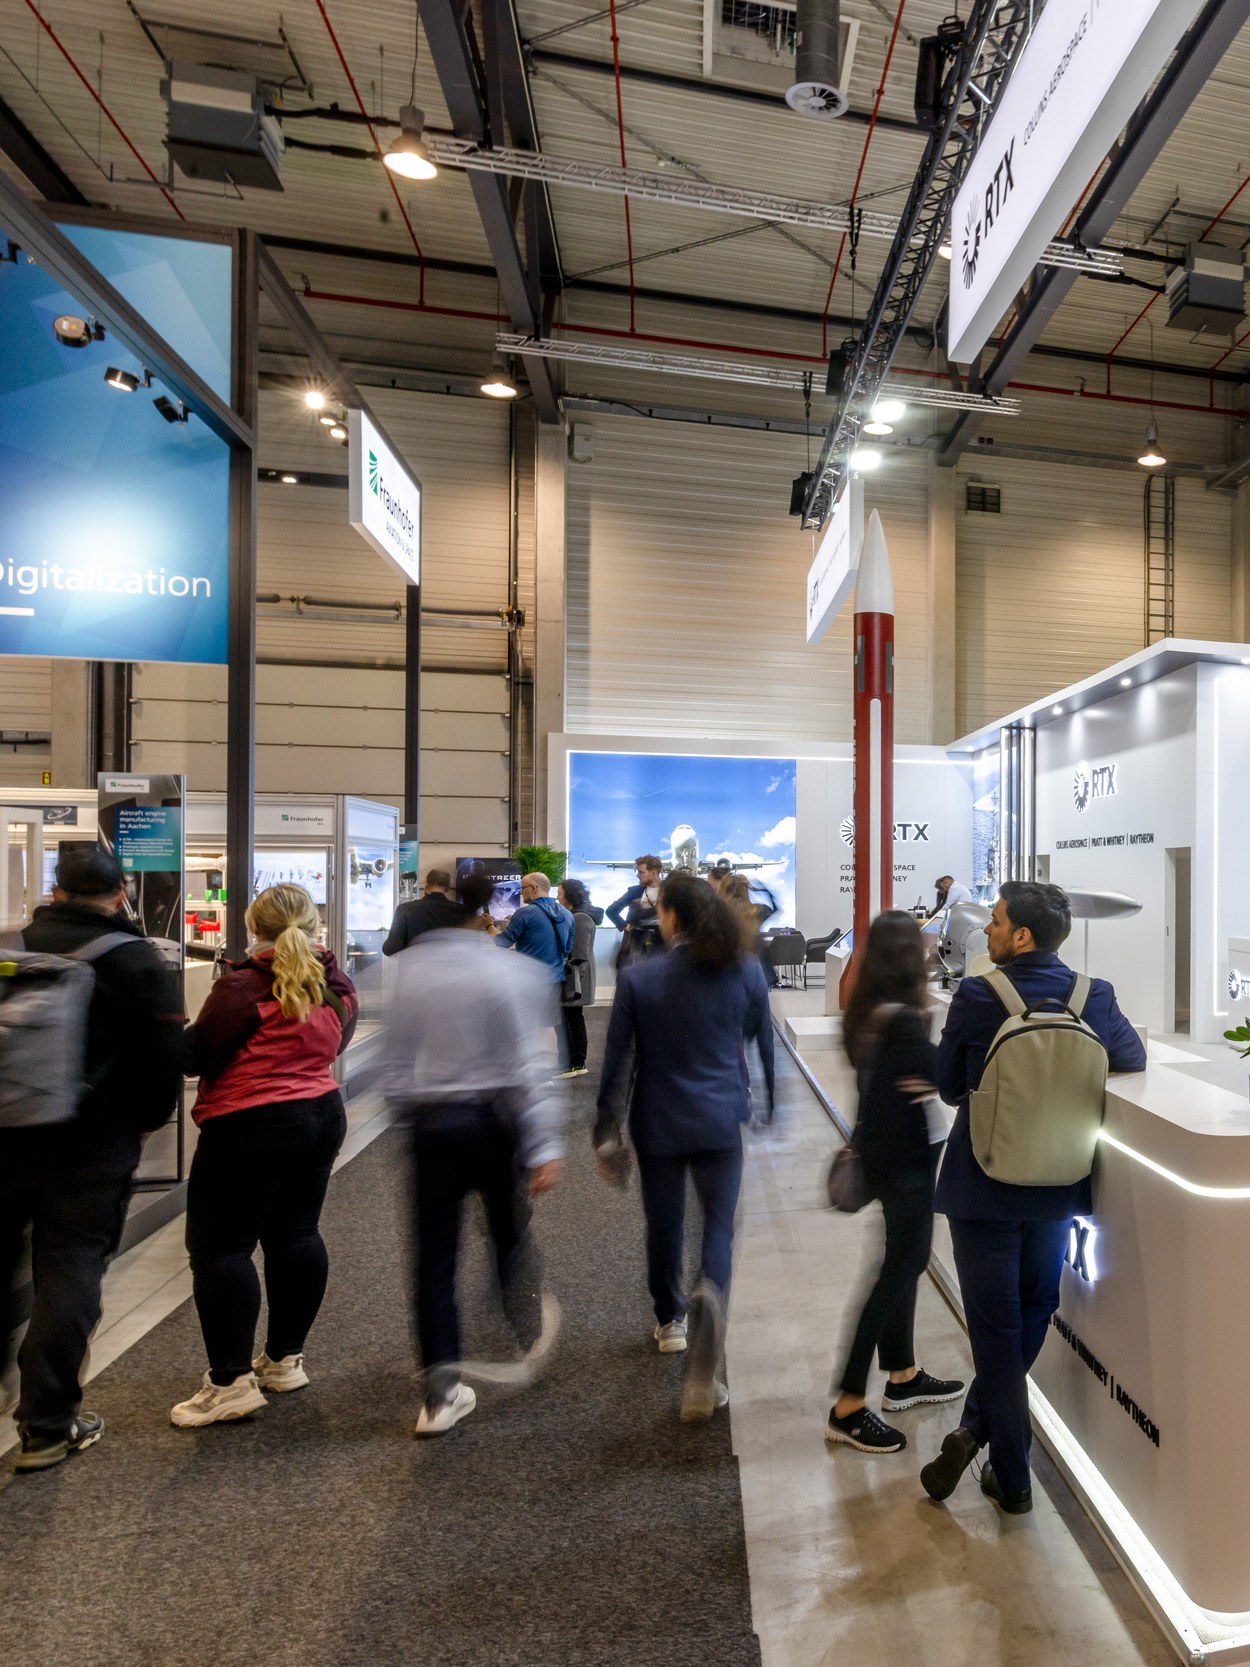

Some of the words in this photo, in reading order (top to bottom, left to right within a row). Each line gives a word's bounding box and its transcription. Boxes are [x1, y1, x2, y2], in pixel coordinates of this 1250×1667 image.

[984, 135, 1015, 240] RTX
[1023, 89, 1048, 147] COLLINS
[1049, 11, 1088, 101] AEROSPACE
[380, 476, 414, 540] Fraunhofer
[0, 557, 211, 598] igitalization
[1091, 764, 1116, 798] RTX
[289, 815, 325, 823] Fraunhofer
[1107, 835, 1125, 846] WHITNEY
[1129, 833, 1154, 845] RAYTHEON
[1116, 1383, 1160, 1448] RAYTHEON
